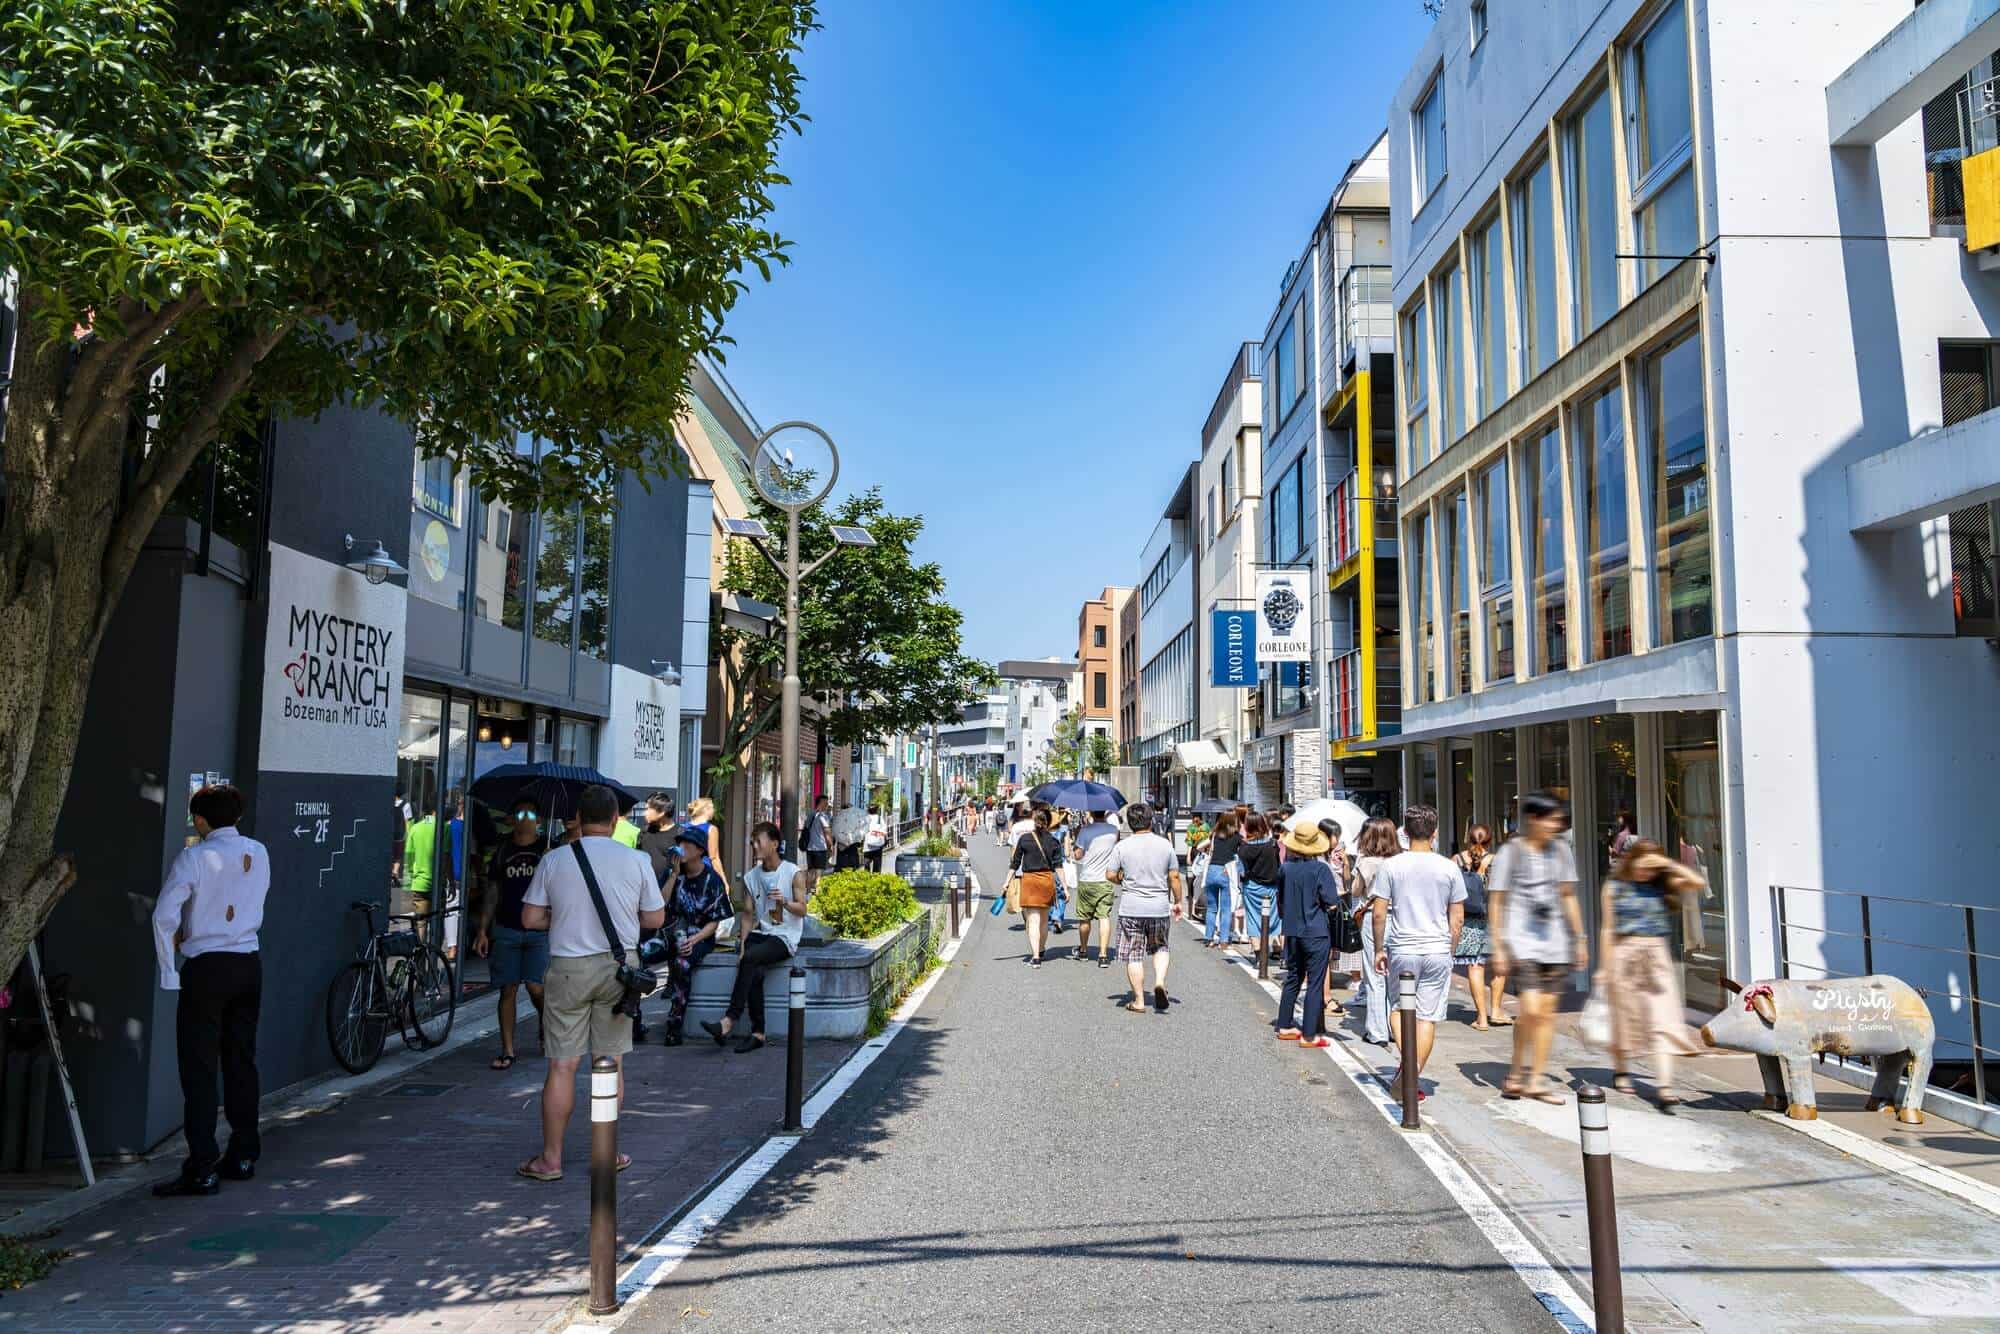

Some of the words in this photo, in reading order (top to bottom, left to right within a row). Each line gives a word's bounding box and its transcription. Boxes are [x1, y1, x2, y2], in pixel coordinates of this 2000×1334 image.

[288, 603, 392, 667] MYSTERY
[1228, 615, 1243, 682] CORLEONE
[1259, 642, 1307, 653] CORLEONE
[307, 655, 390, 708] RANCH
[284, 695, 338, 723] Bozeman
[343, 705, 361, 725] MT
[365, 709, 388, 728] USA
[635, 699, 665, 727] MYSTERY
[640, 726, 665, 751] RANCH
[295, 802, 331, 816] TECHNICAL
[314, 819, 330, 843] 2F
[1812, 988, 1896, 1021] Pigsty
